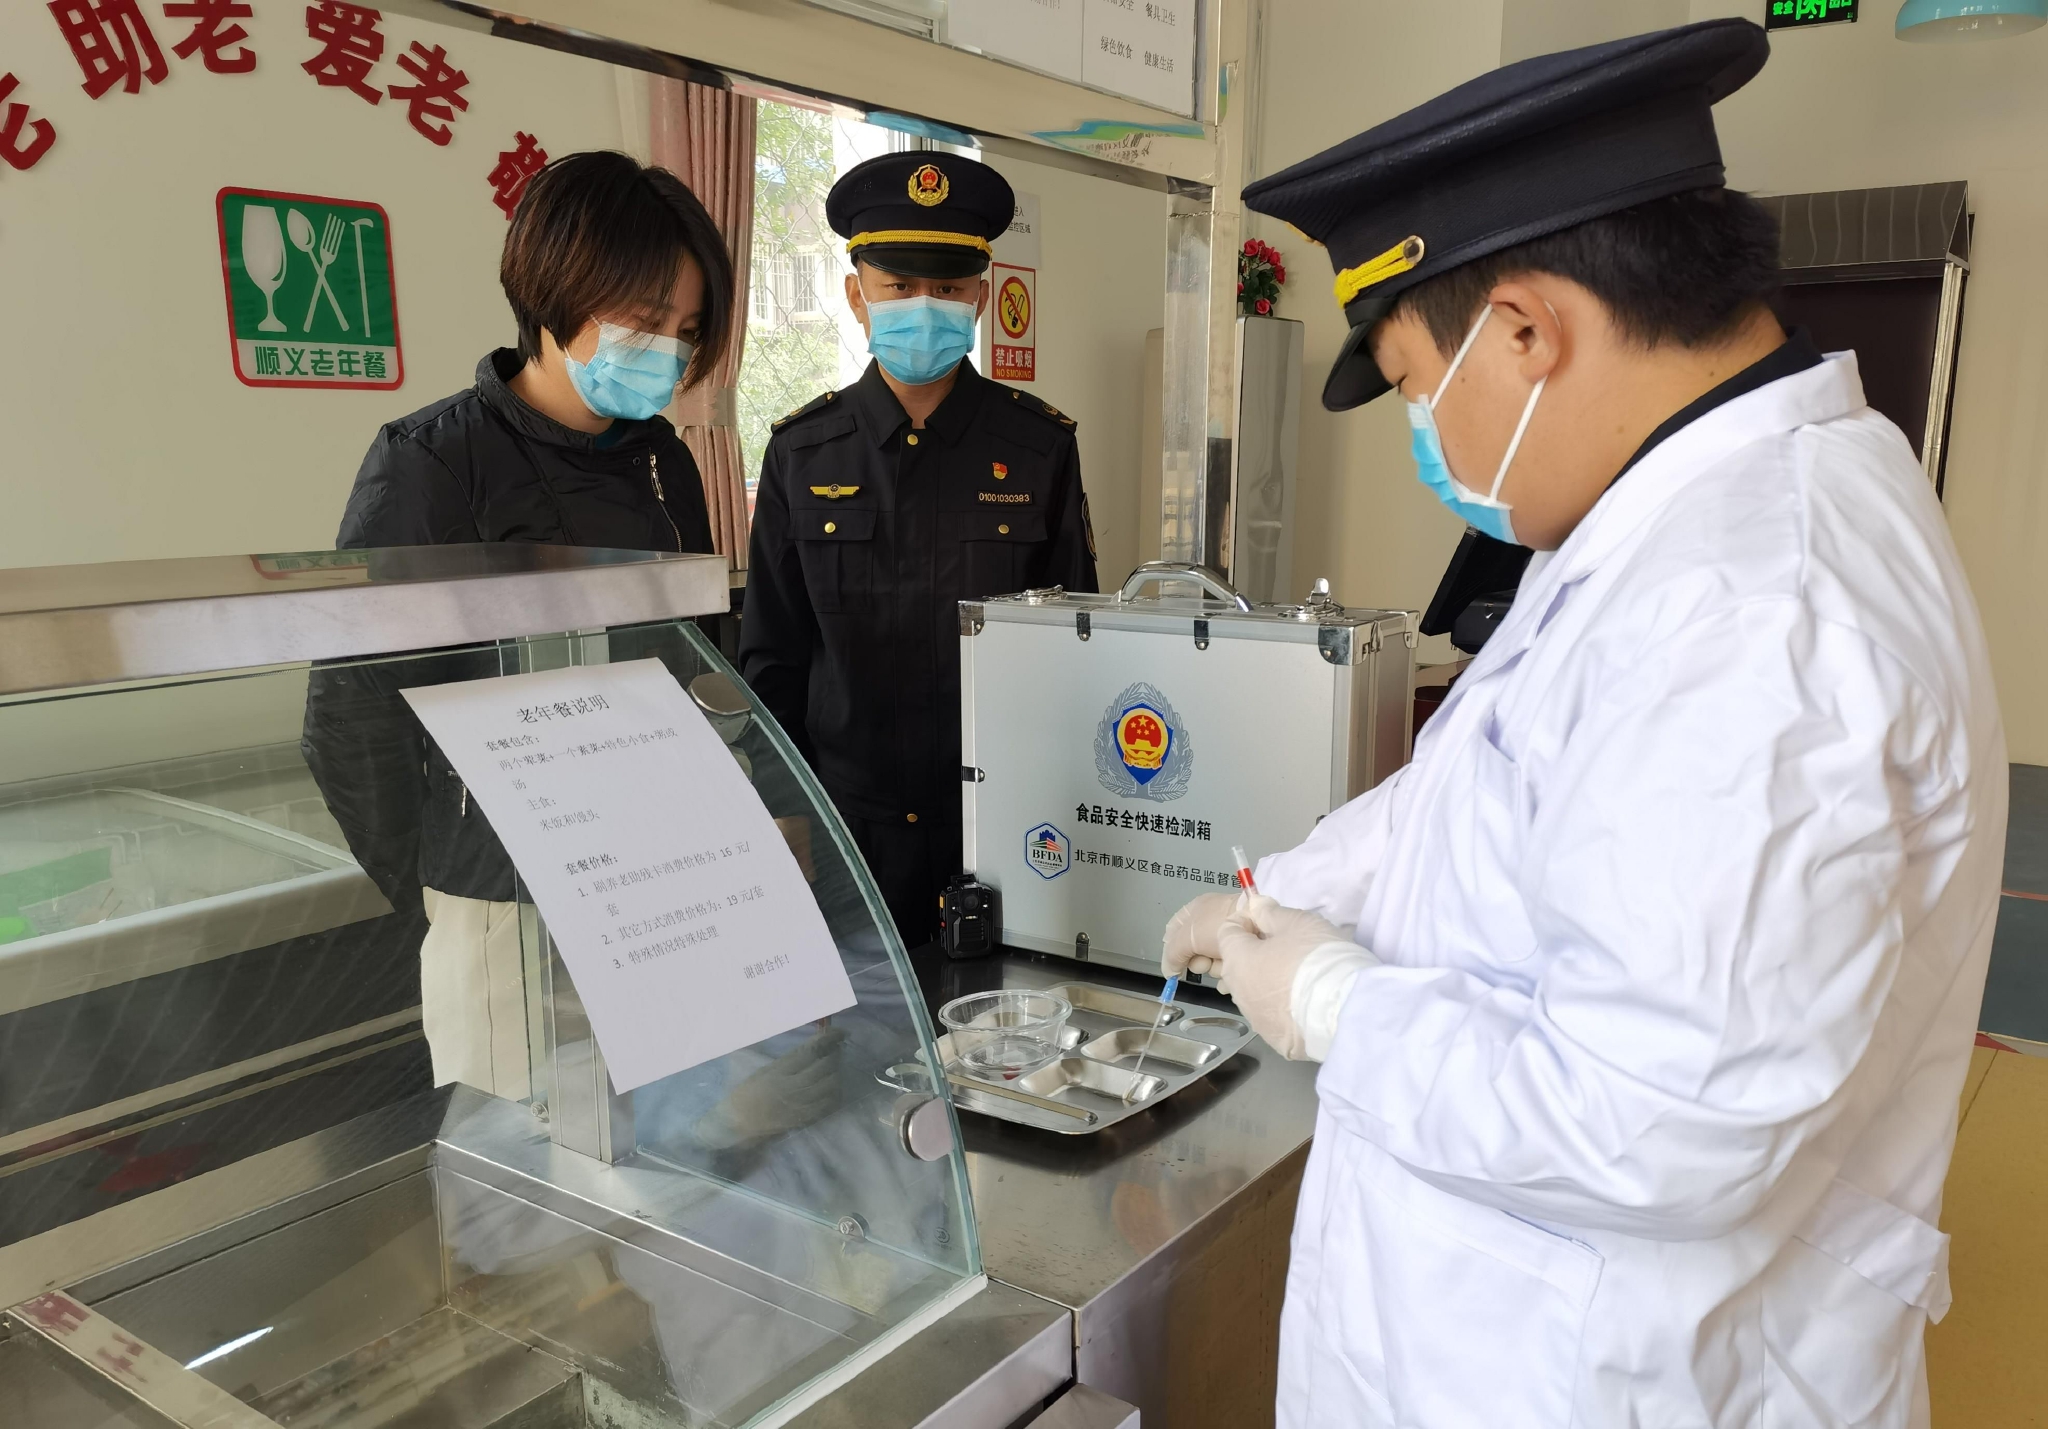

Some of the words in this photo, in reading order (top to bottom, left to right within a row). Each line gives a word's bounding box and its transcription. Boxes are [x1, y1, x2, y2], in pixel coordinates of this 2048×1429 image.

[1145, 2, 1176, 26] 餐具卫生
[1100, 36, 1133, 59] 绿色饮食
[1144, 50, 1174, 73] 健康生活
[254, 346, 387, 378] 顺义老年餐
[995, 347, 1033, 369] 禁止吸烟
[996, 368, 1006, 378] NO
[1006, 368, 1032, 379] SMOKING
[978, 492, 1030, 503] 01001030383
[516, 694, 610, 724] 老年餐说明
[485, 734, 540, 752] 套餐包含:
[511, 778, 528, 791] 汤
[526, 796, 557, 812] 主食:
[539, 808, 601, 832] 米饭和馒头
[1075, 802, 1212, 842] 食品安全快速检测箱
[564, 853, 619, 876] 套餐价格:
[1032, 849, 1063, 863] BFDA
[577, 886, 589, 898] 1.
[593, 850, 717, 894] 刷养老助残卡消费价格为
[719, 846, 733, 858] 16
[601, 934, 613, 945] 2.
[617, 900, 723, 941] 其它方式消费价格为:
[726, 894, 739, 907] 19
[740, 885, 765, 902] 元/套
[606, 902, 620, 917] 套
[612, 958, 625, 969] 3.
[628, 925, 720, 965] 特殊情况特殊处理
[743, 953, 791, 980] 谢谢合作!
